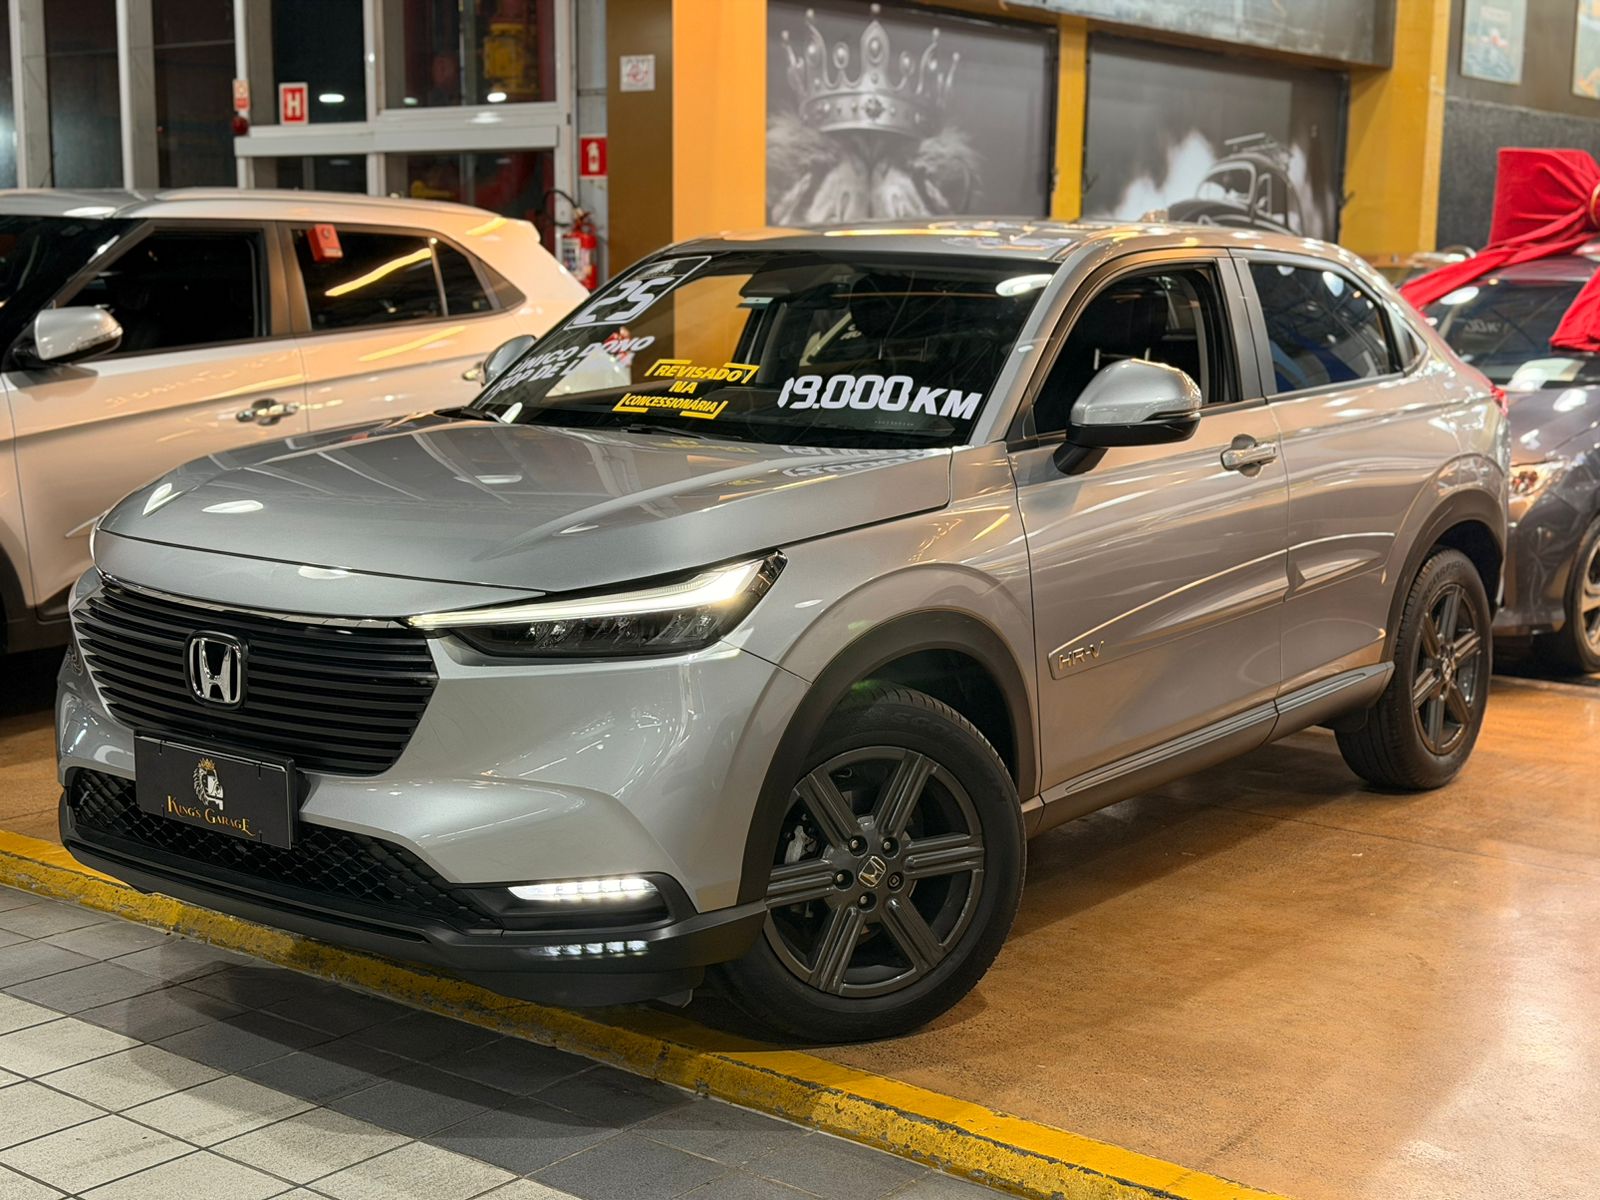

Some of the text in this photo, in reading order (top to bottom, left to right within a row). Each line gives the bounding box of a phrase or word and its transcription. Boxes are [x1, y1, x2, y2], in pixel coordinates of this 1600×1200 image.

[287, 91, 302, 119] H
[572, 276, 676, 325] 25
[527, 361, 568, 383] DE
[653, 365, 743, 382] REVISADO
[668, 380, 699, 394] NA
[777, 374, 983, 420] 19.000 KM
[624, 395, 719, 413] CONCESSIONÁRIA
